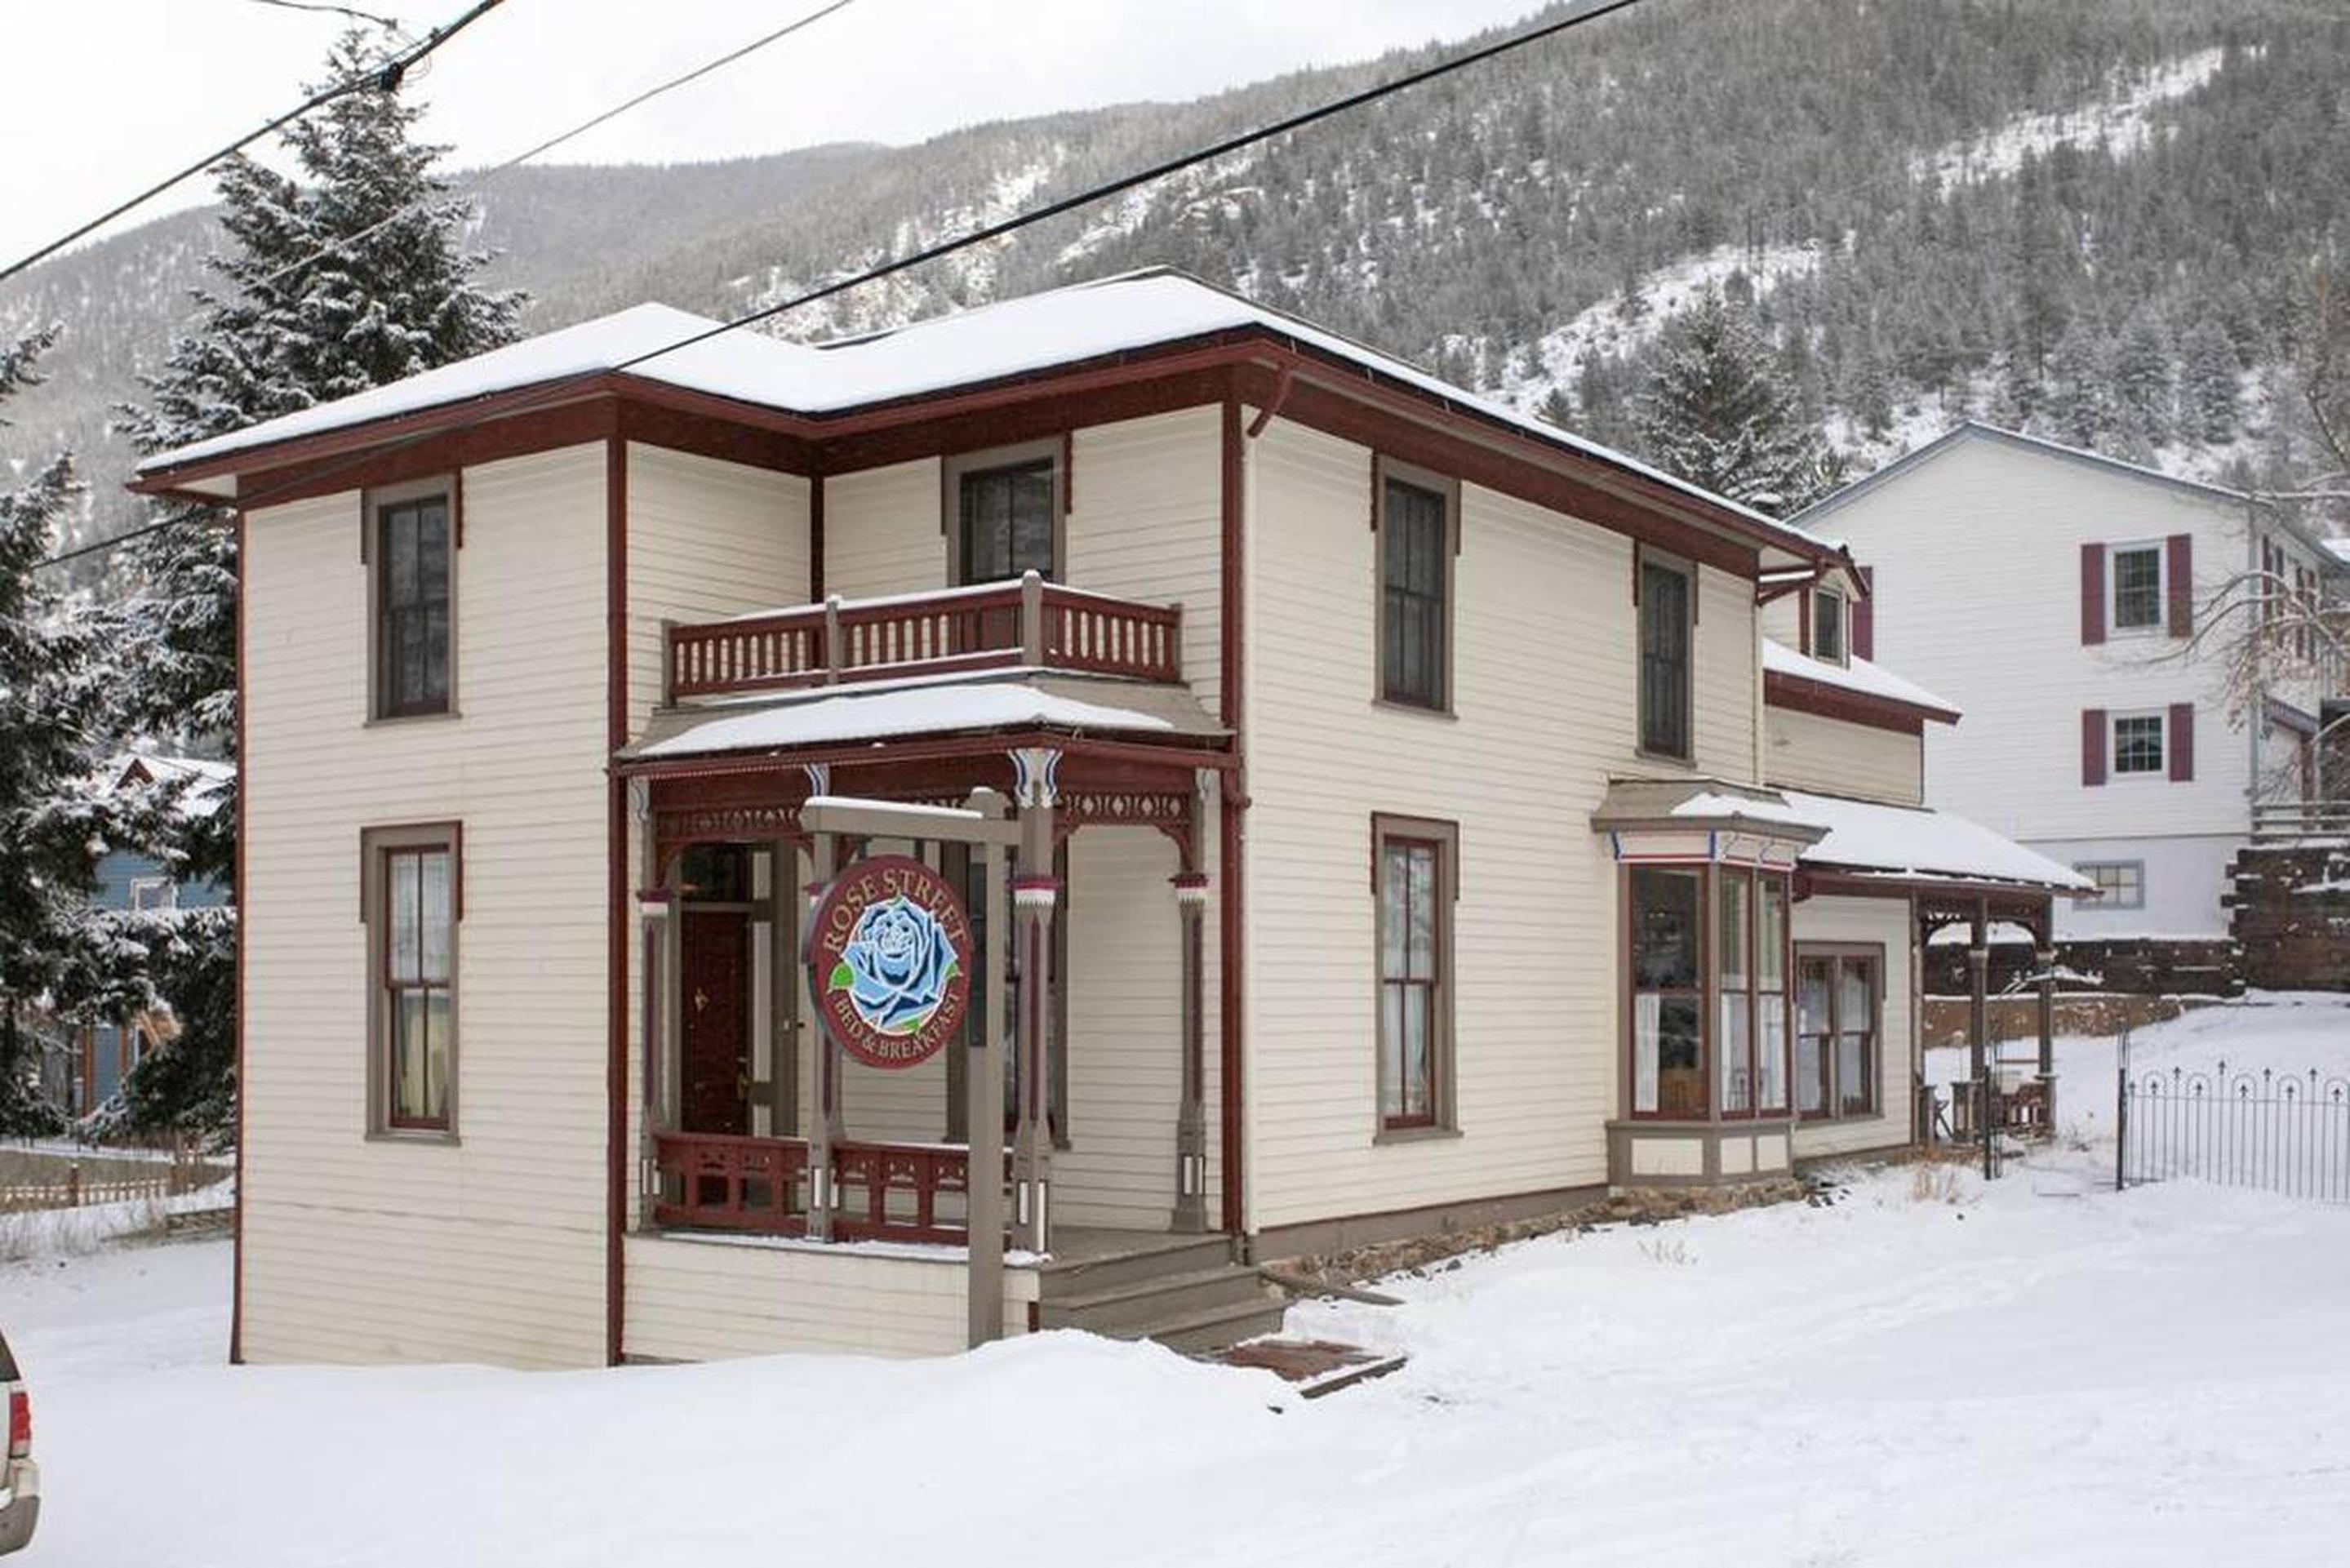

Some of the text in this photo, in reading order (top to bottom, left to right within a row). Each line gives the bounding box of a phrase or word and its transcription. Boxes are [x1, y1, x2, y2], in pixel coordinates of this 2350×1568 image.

[824, 868, 967, 953] ROSE STREET
[833, 989, 962, 1059] BED & BREAKFAST
